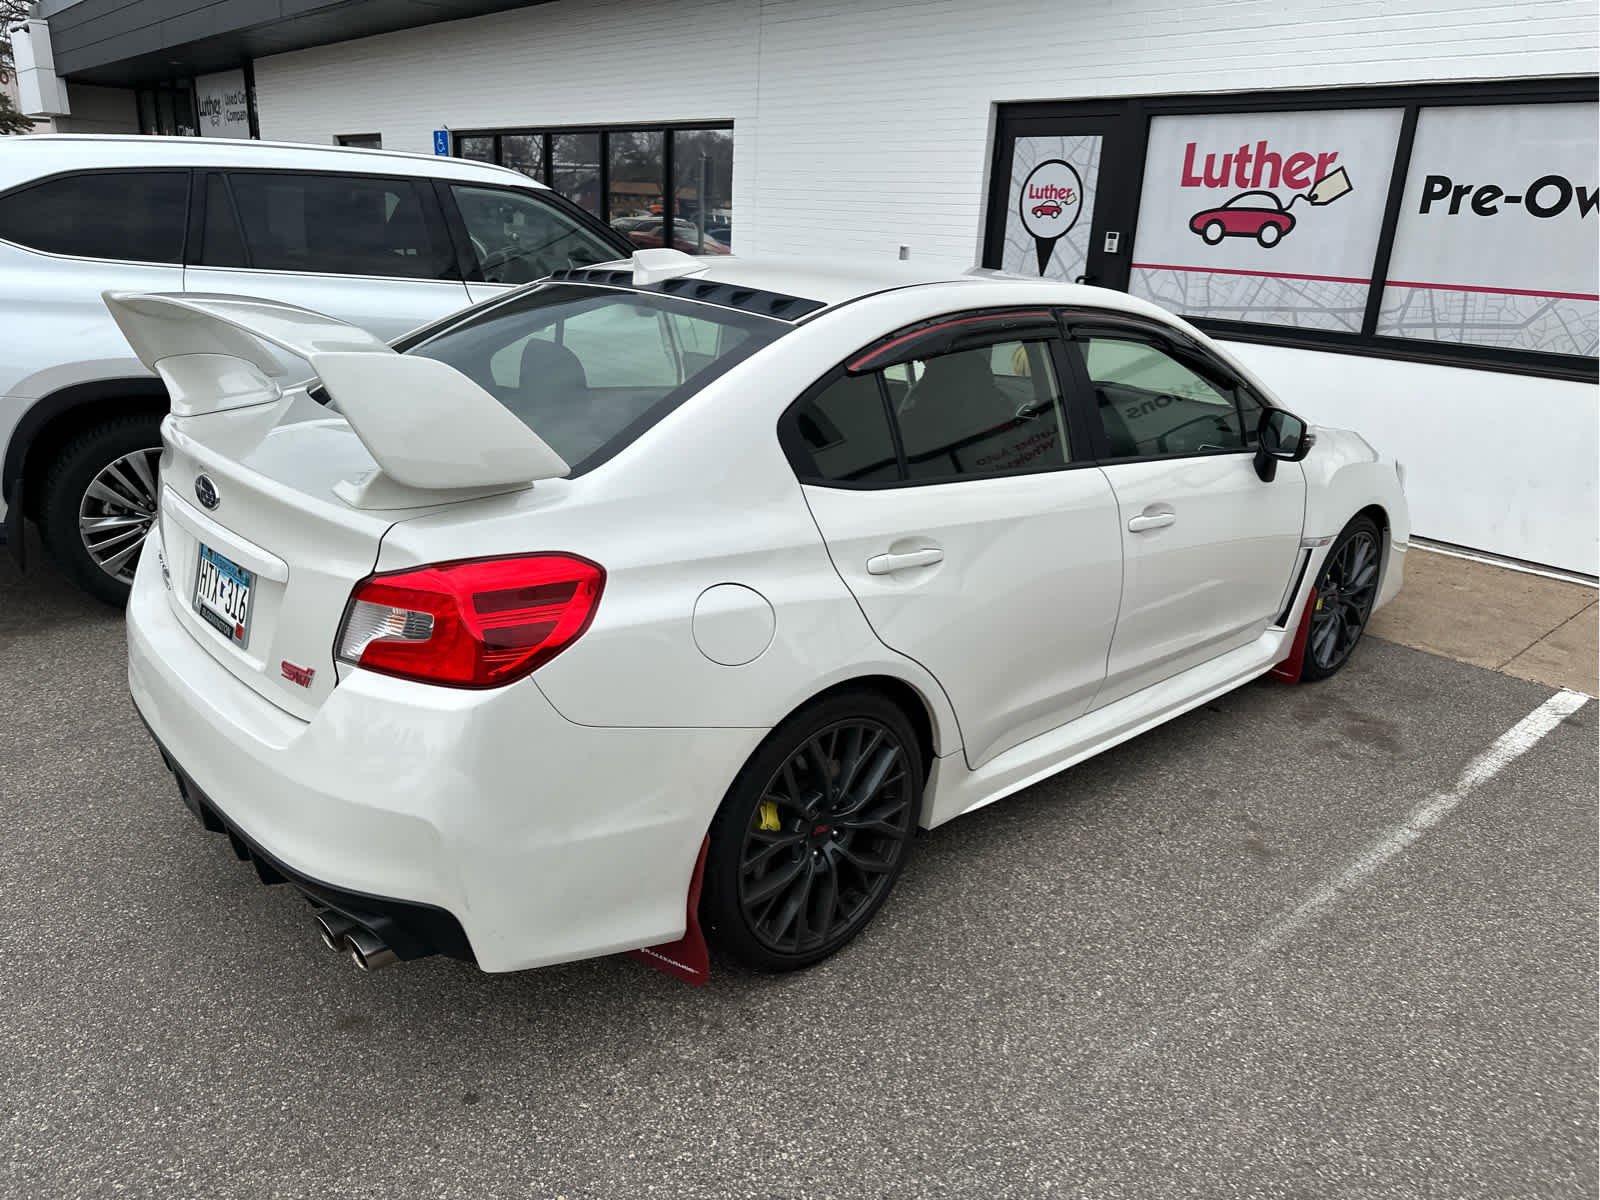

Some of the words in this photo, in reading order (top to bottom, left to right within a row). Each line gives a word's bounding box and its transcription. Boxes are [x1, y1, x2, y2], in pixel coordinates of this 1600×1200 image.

[198, 94, 222, 117] Luther
[1181, 140, 1339, 189] Luther
[1028, 183, 1073, 200] Luther
[199, 558, 221, 605] HTX
[225, 577, 249, 625] 316
